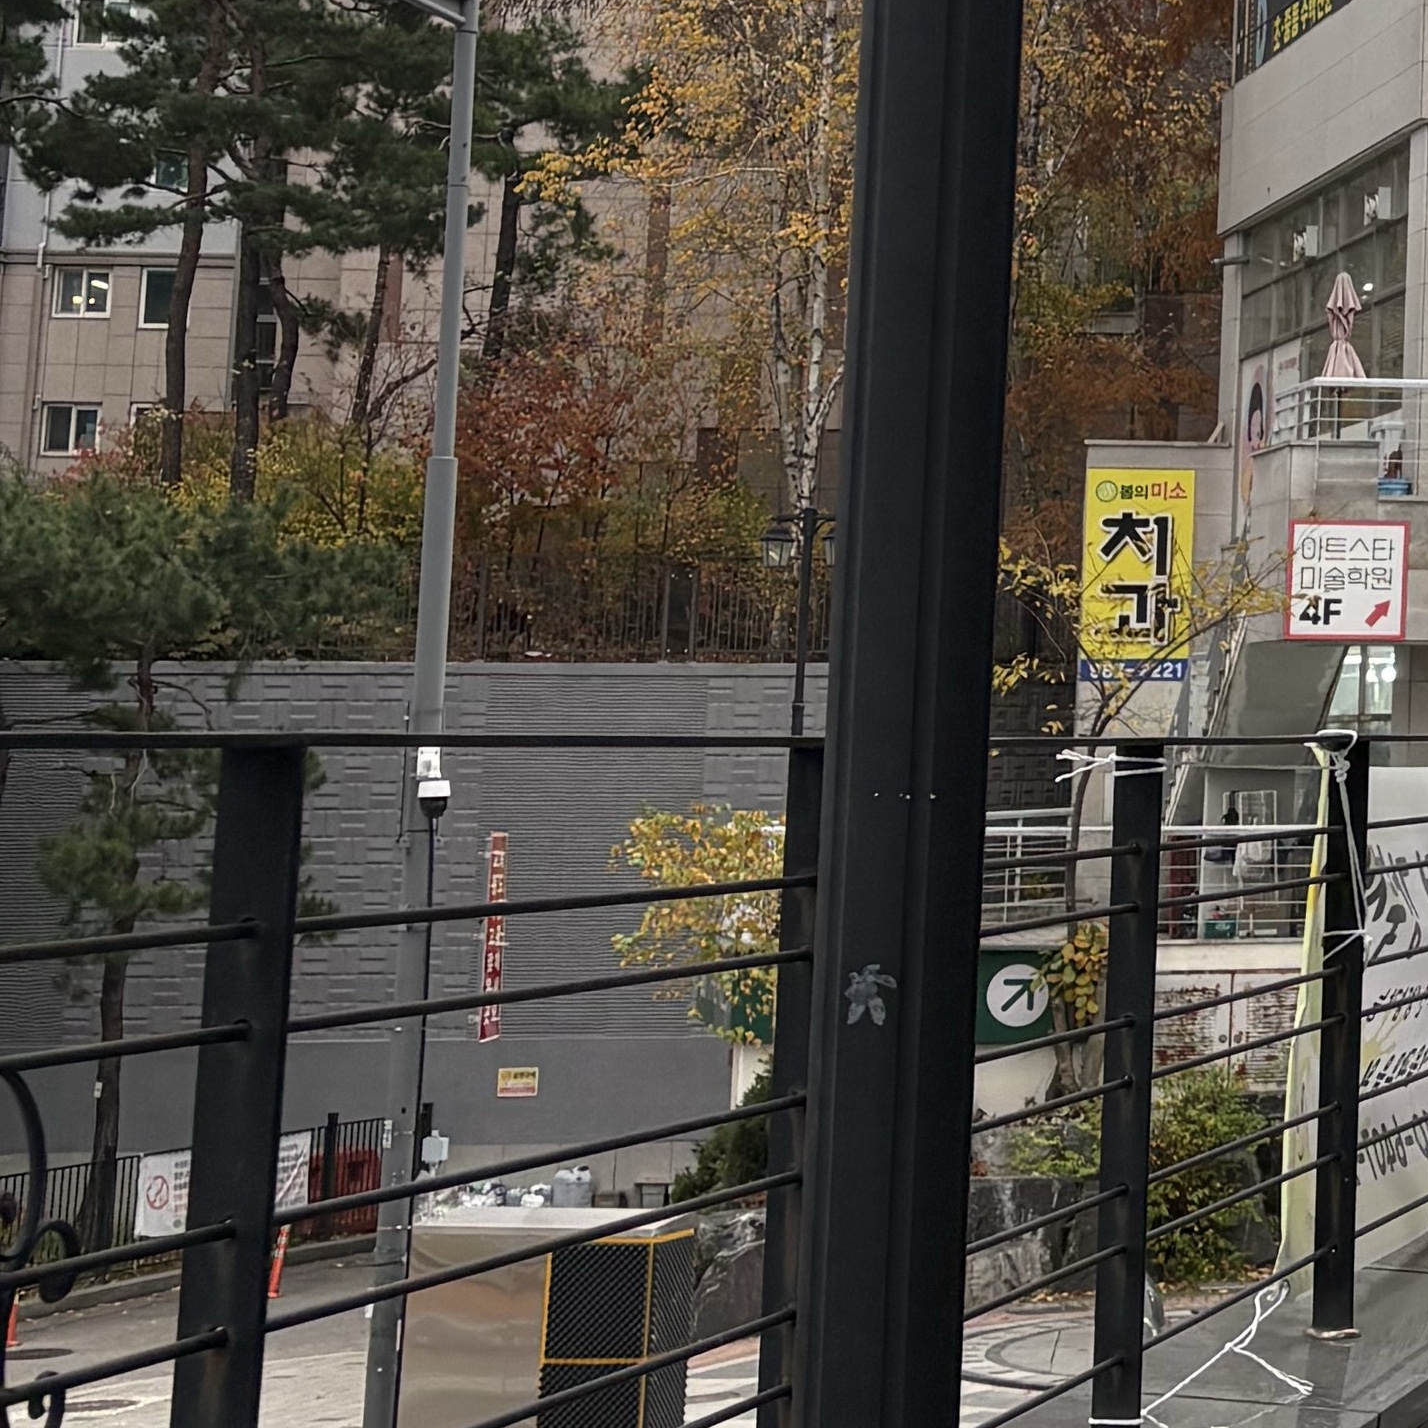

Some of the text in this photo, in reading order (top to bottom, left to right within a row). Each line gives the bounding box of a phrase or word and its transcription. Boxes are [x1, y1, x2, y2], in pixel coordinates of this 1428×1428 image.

[1300, 535, 1396, 563] 아트스타
[1299, 565, 1393, 591] 미술학원
[1297, 596, 1342, 626] 4F
